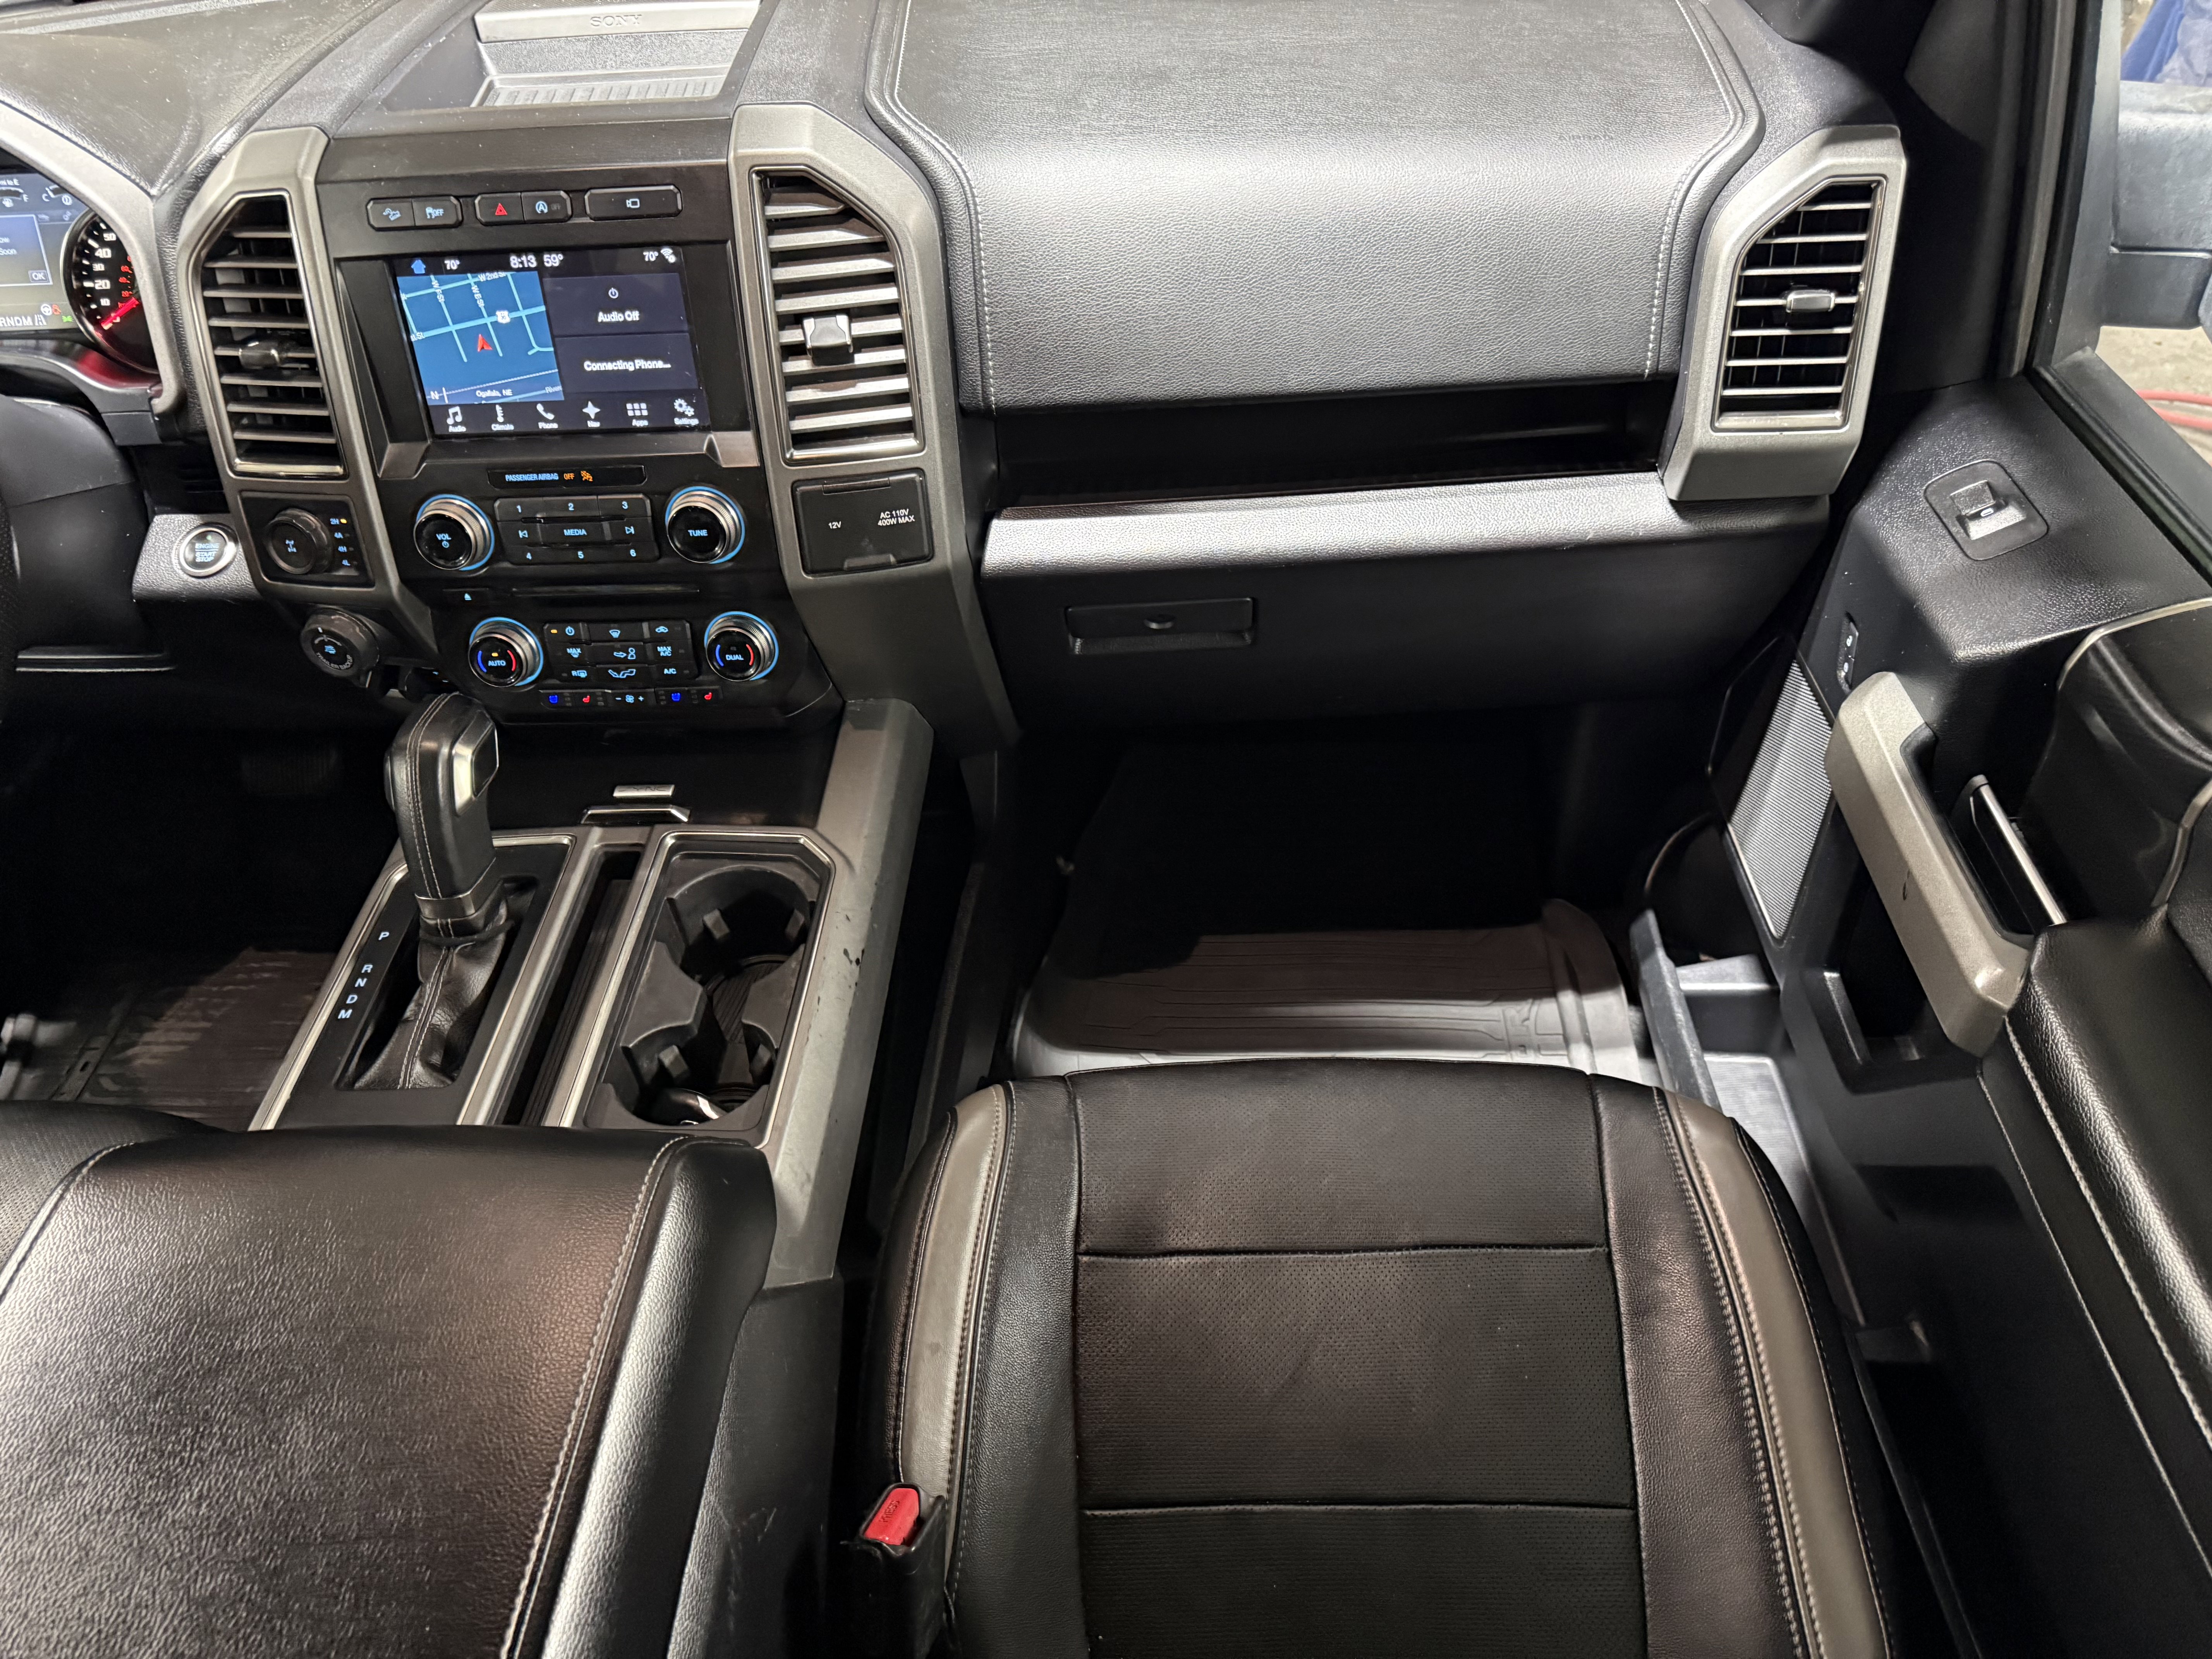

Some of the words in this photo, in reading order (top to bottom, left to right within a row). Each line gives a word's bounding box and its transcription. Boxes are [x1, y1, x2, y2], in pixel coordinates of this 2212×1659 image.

[590, 14, 642, 27] SONY
[42, 194, 50, 202] C
[94, 248, 112, 258] 40
[510, 254, 537, 268] 8:13
[32, 272, 46, 280] OK
[94, 280, 111, 290] 20
[598, 311, 624, 322] Audio
[624, 310, 639, 321] Off
[584, 361, 635, 371] Connecting
[634, 359, 671, 369] Phone...
[430, 391, 439, 400] N
[892, 508, 909, 517] 110V
[878, 518, 897, 526] 400W
[898, 515, 915, 524] MAX
[578, 551, 584, 559] 5
[378, 931, 390, 940] P
[361, 964, 373, 973] R
[355, 978, 367, 987] N
[346, 995, 358, 1004] D
[338, 1009, 352, 1019] M
